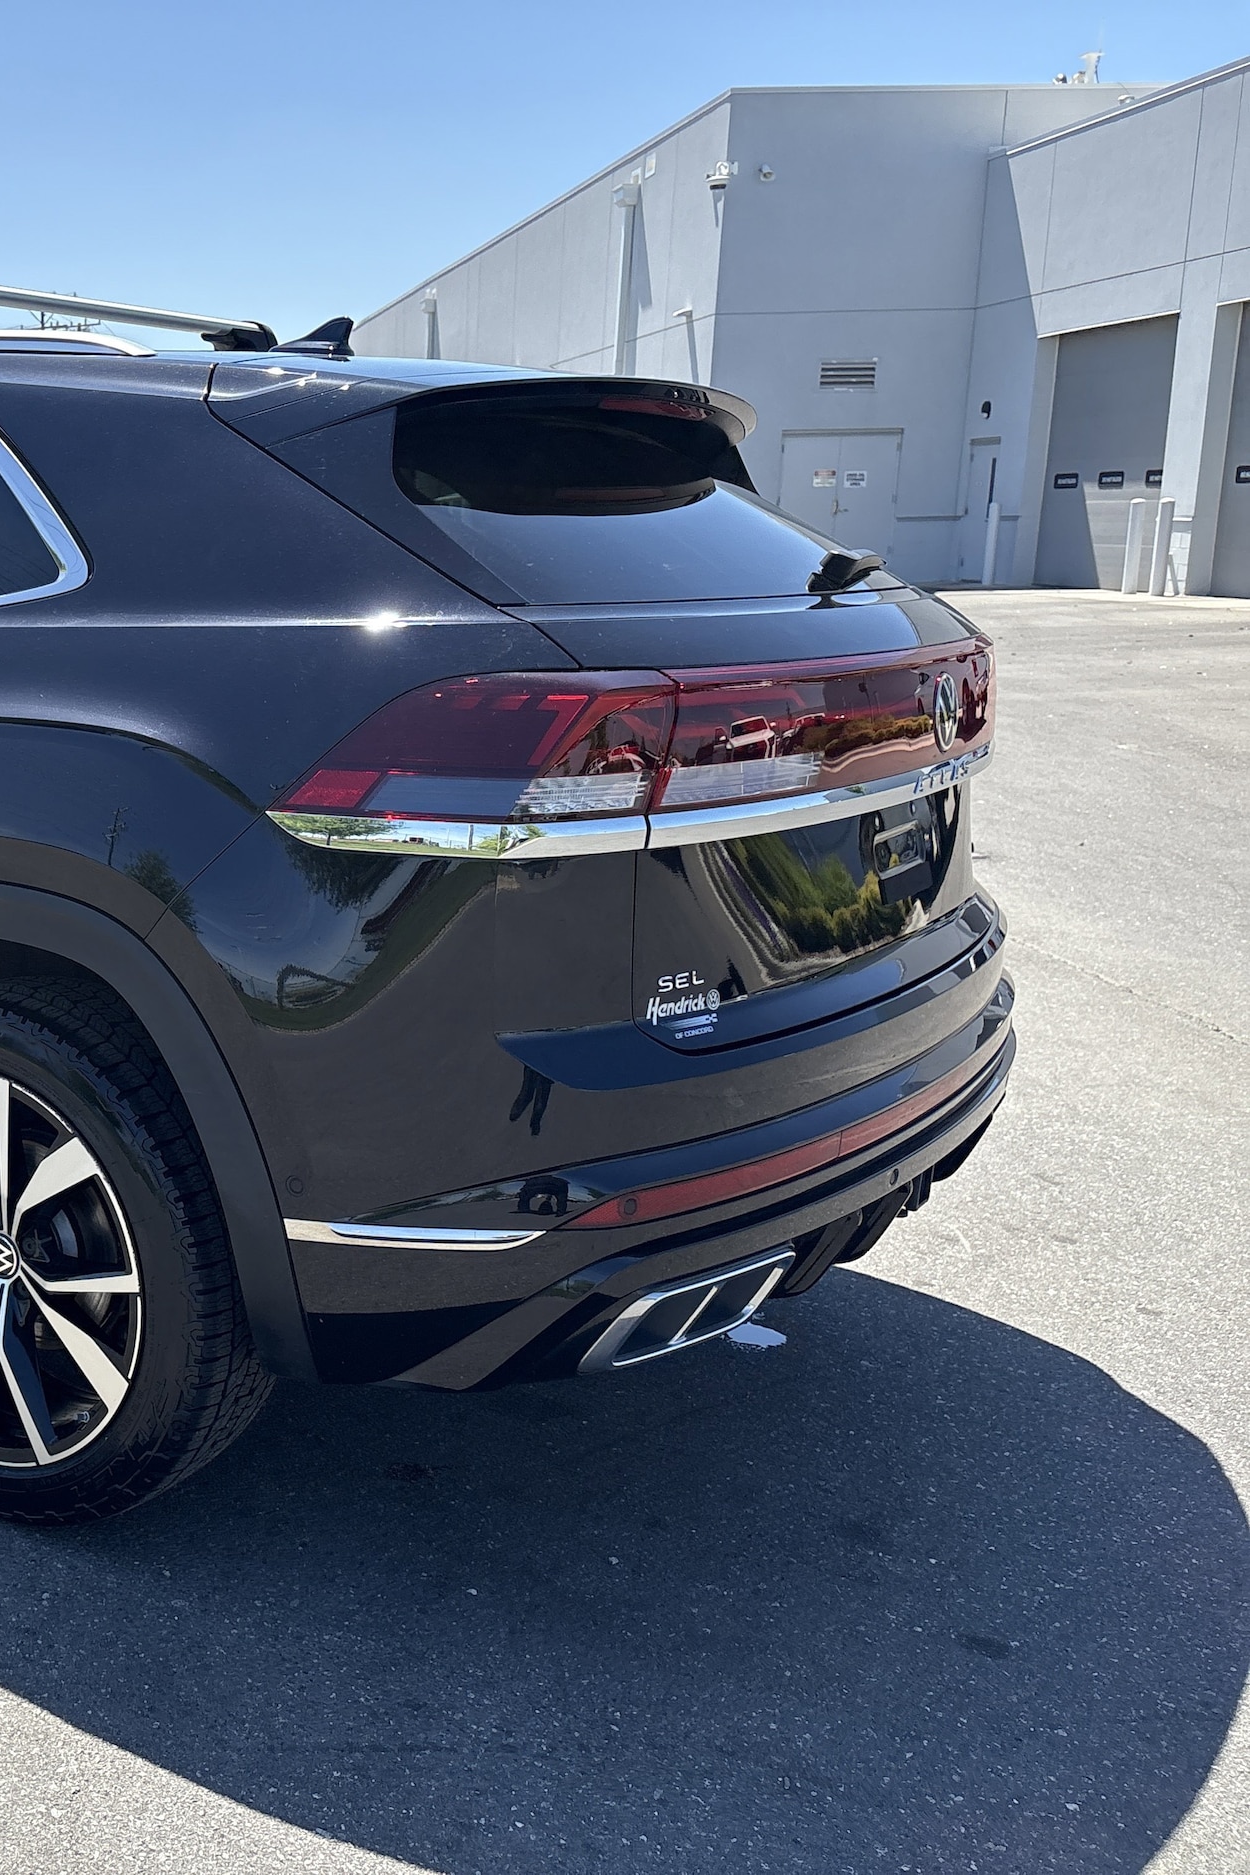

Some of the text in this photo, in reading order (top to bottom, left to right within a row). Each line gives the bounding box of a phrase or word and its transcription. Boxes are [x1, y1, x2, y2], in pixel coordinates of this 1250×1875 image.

[657, 970, 705, 993] SEL
[645, 992, 706, 1027] Hendrick
[674, 1025, 715, 1040] OF CONCORD
